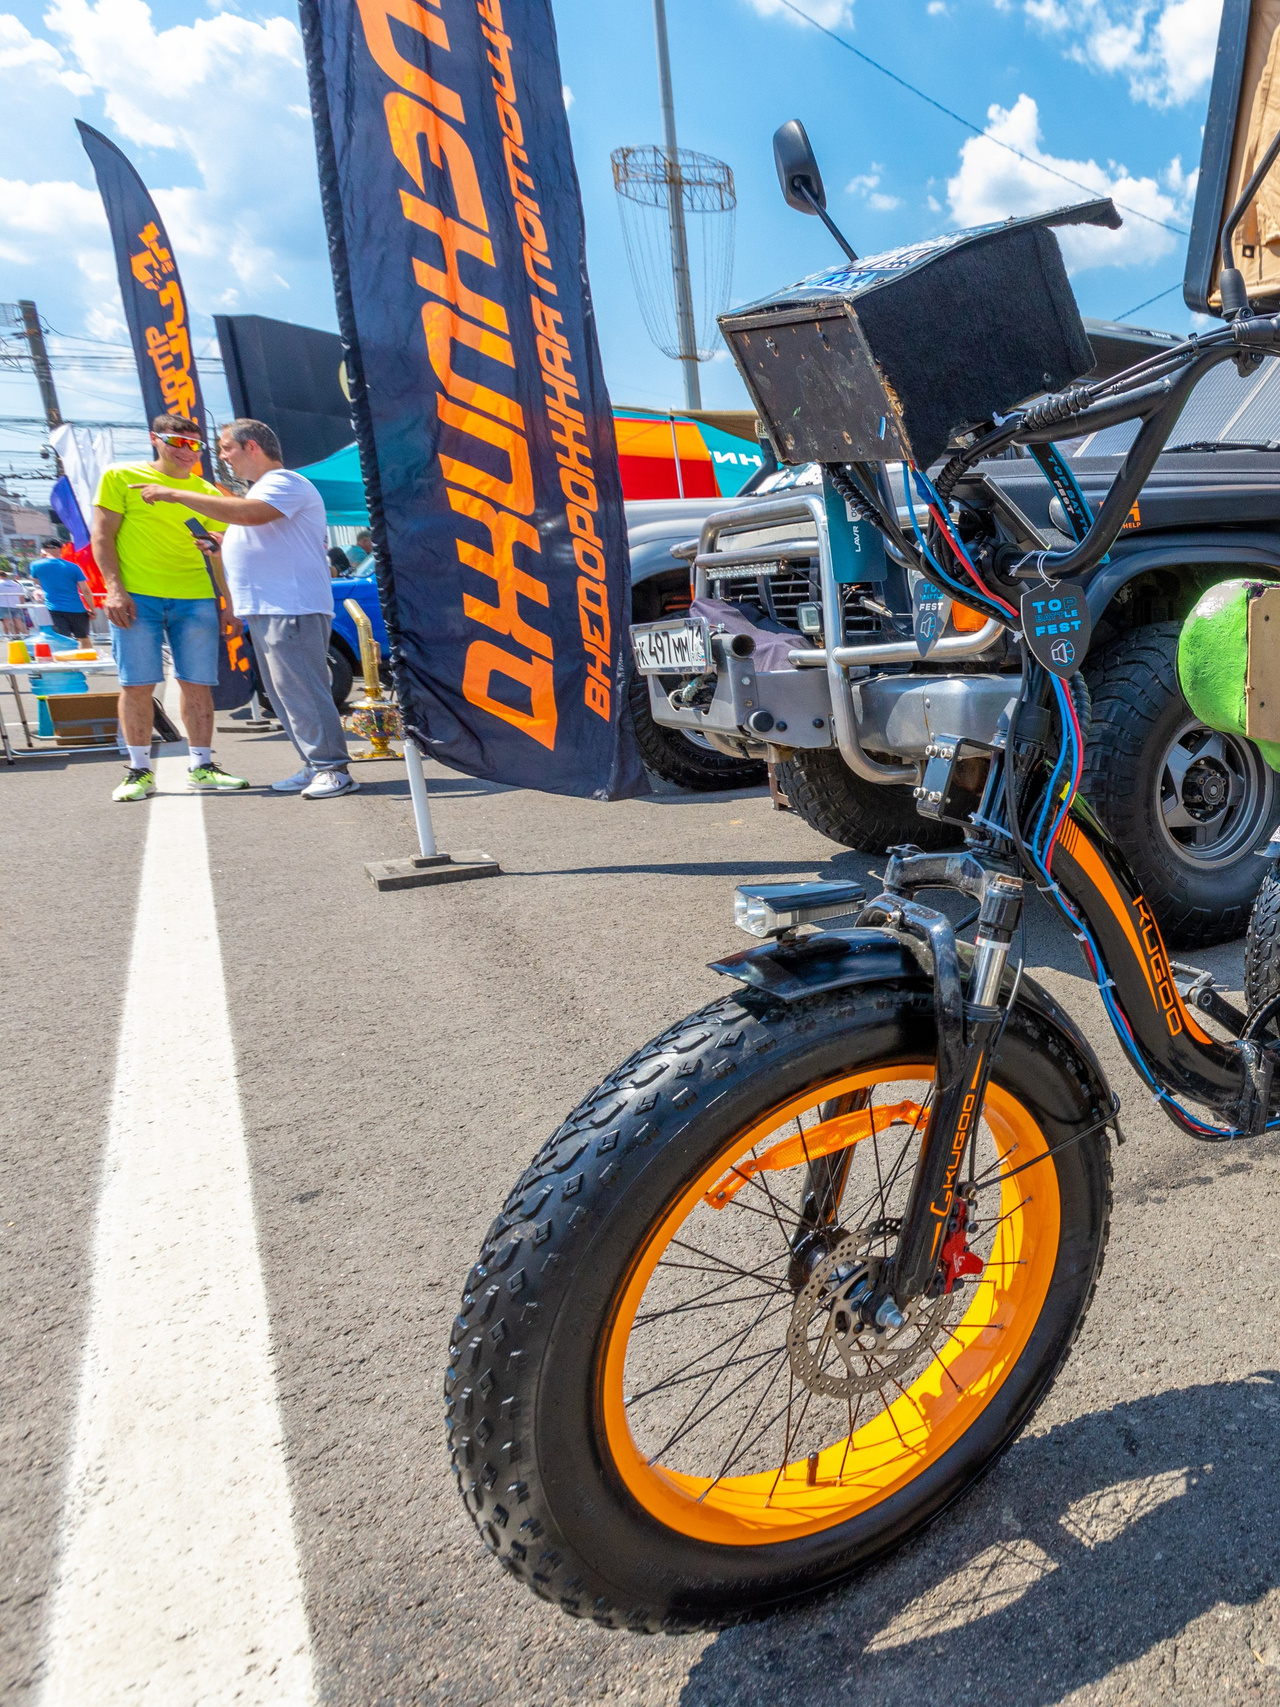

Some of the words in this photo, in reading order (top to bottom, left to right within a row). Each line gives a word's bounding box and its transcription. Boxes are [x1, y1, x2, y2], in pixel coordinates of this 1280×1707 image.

[357, 0, 558, 751] ДЖИПХЭЛ
[530, 295, 611, 721] ВНЕДОРОЖНАЯ
[1048, 455, 1069, 487] TOP
[1065, 489, 1091, 536] BATTL
[1053, 480, 1075, 515] FEST
[852, 525, 862, 553] LAVR
[921, 593, 944, 601] BATTLE
[922, 582, 941, 594] TO
[919, 602, 944, 611] FEST
[1031, 596, 1078, 614] TOP
[1034, 609, 1079, 623] BATTLE
[1034, 620, 1082, 637] FEST
[1132, 894, 1183, 1037] KUGOO
[942, 1093, 976, 1189] KUGOO
